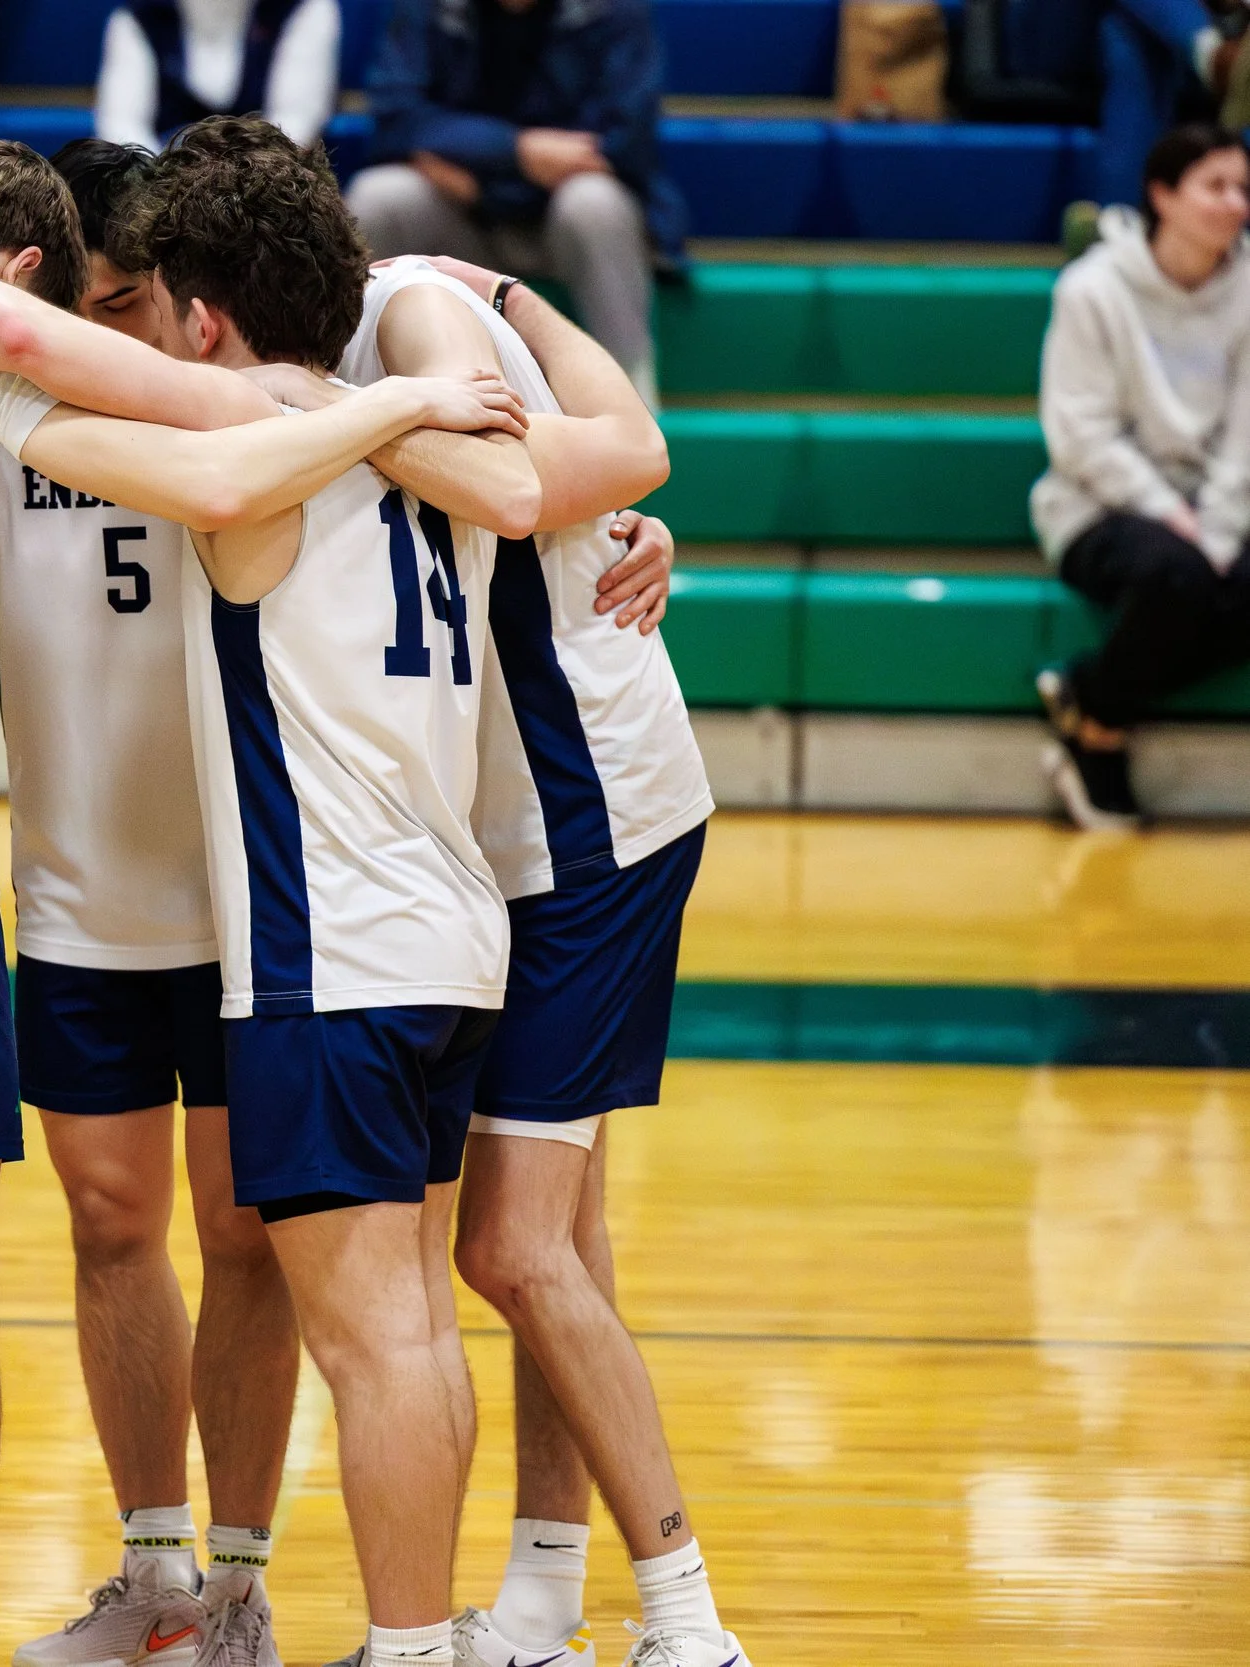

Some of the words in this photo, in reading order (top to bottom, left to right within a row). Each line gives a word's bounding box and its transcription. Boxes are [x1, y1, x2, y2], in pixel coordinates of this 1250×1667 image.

[102, 526, 152, 613] 5
[378, 488, 473, 685] 14
[660, 1511, 682, 1537] P3
